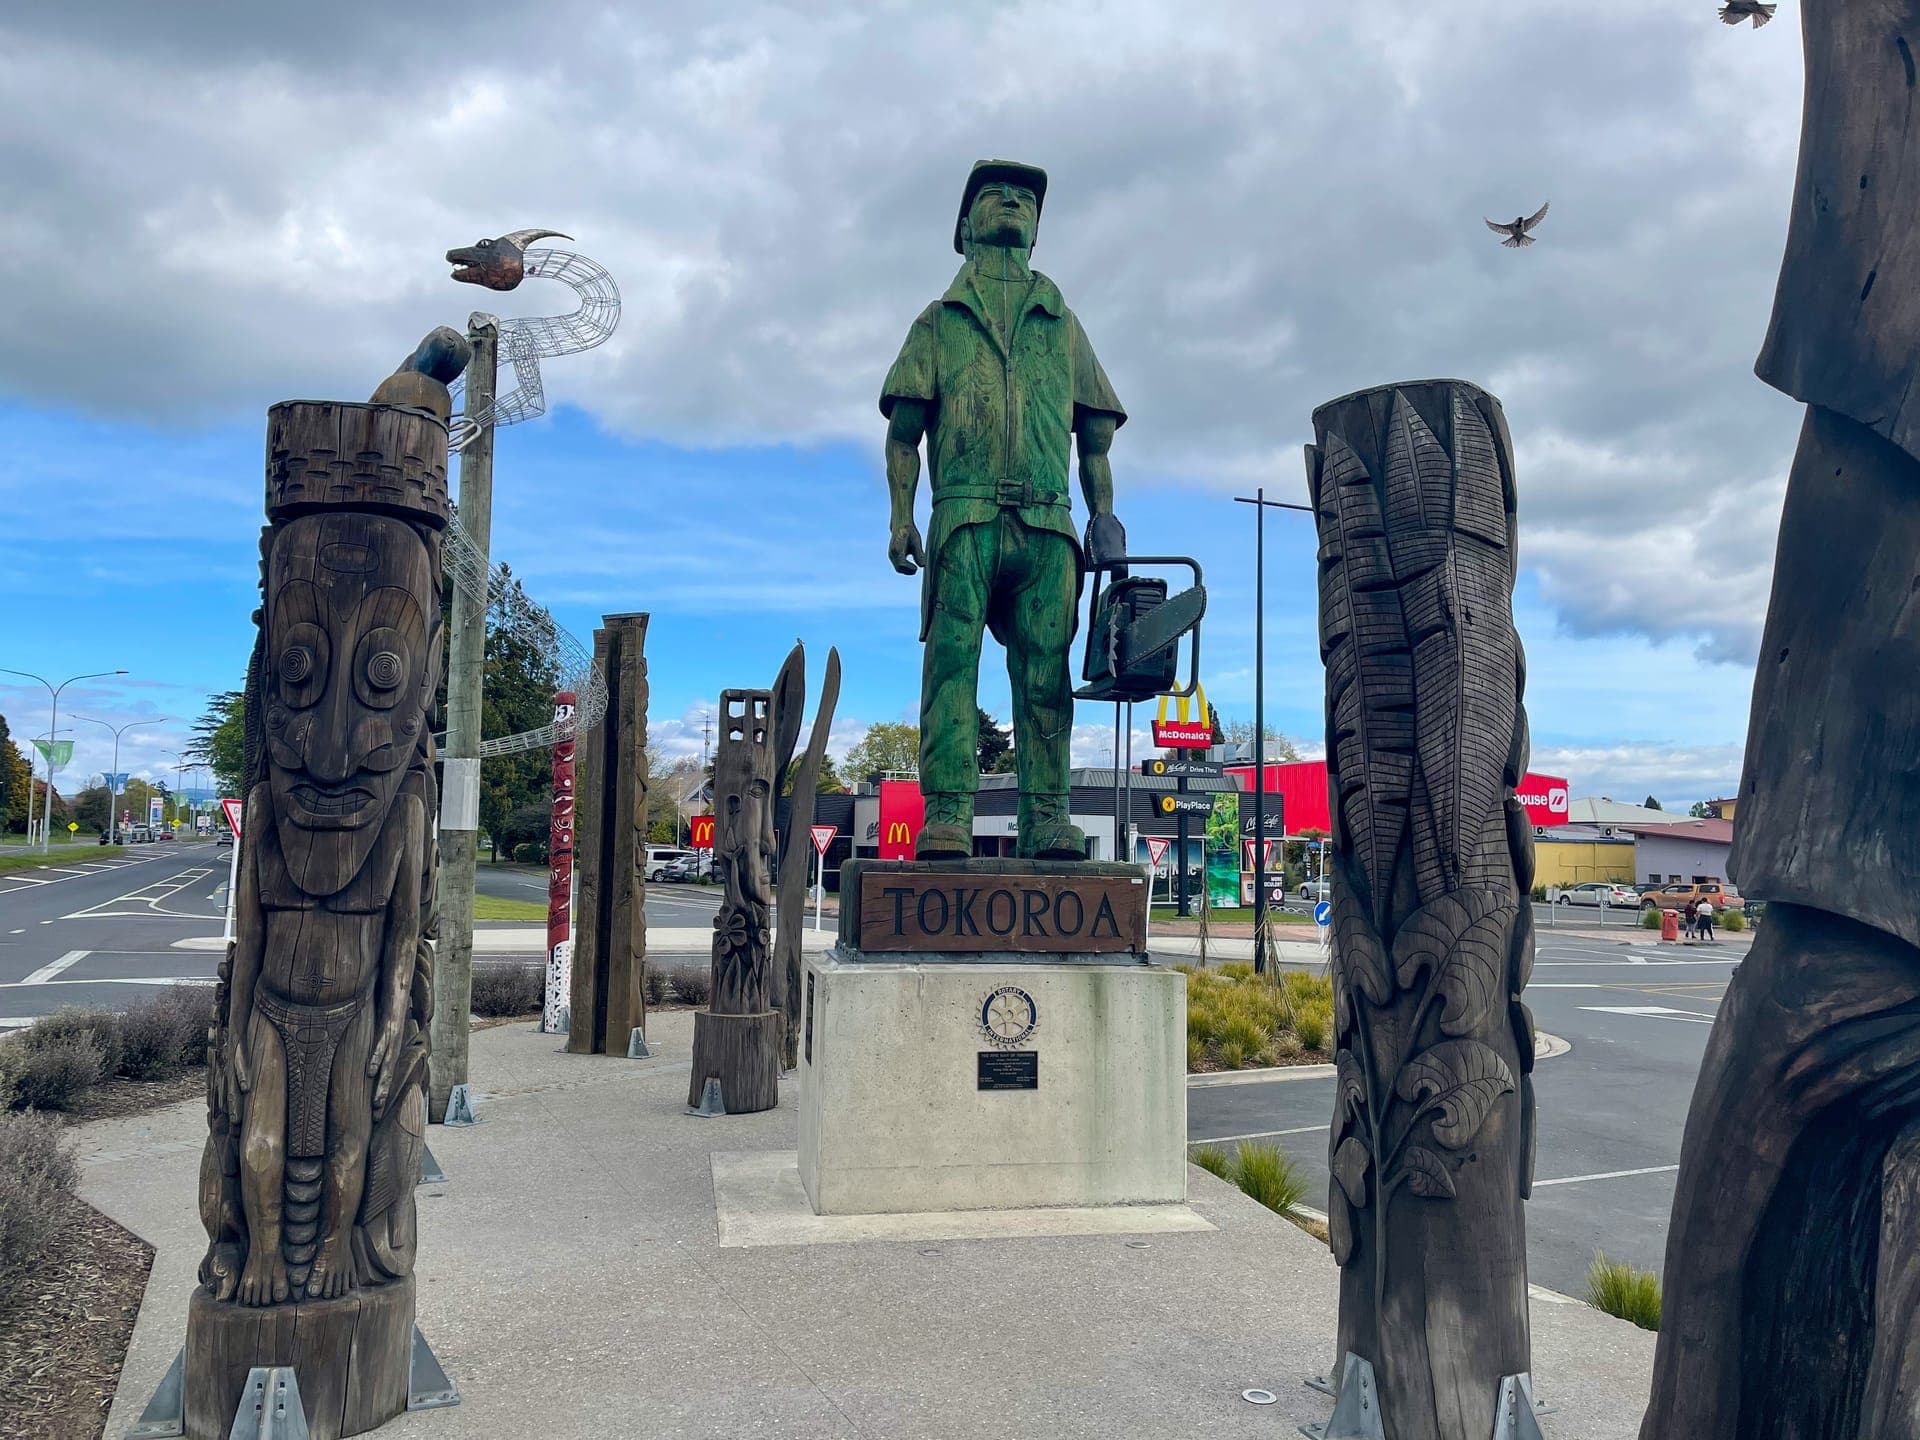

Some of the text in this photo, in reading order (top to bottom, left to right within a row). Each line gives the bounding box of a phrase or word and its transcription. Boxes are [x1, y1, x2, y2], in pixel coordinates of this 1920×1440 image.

[1158, 730, 1211, 742] McDonald's
[1189, 765, 1204, 773] Drive
[1204, 766, 1217, 774] Thru
[1176, 800, 1211, 811] PlayPlace
[883, 887, 1123, 938] TOKOROA
[997, 987, 1021, 995] ROTARY
[987, 1026, 1033, 1044] INTERNATIONAL
